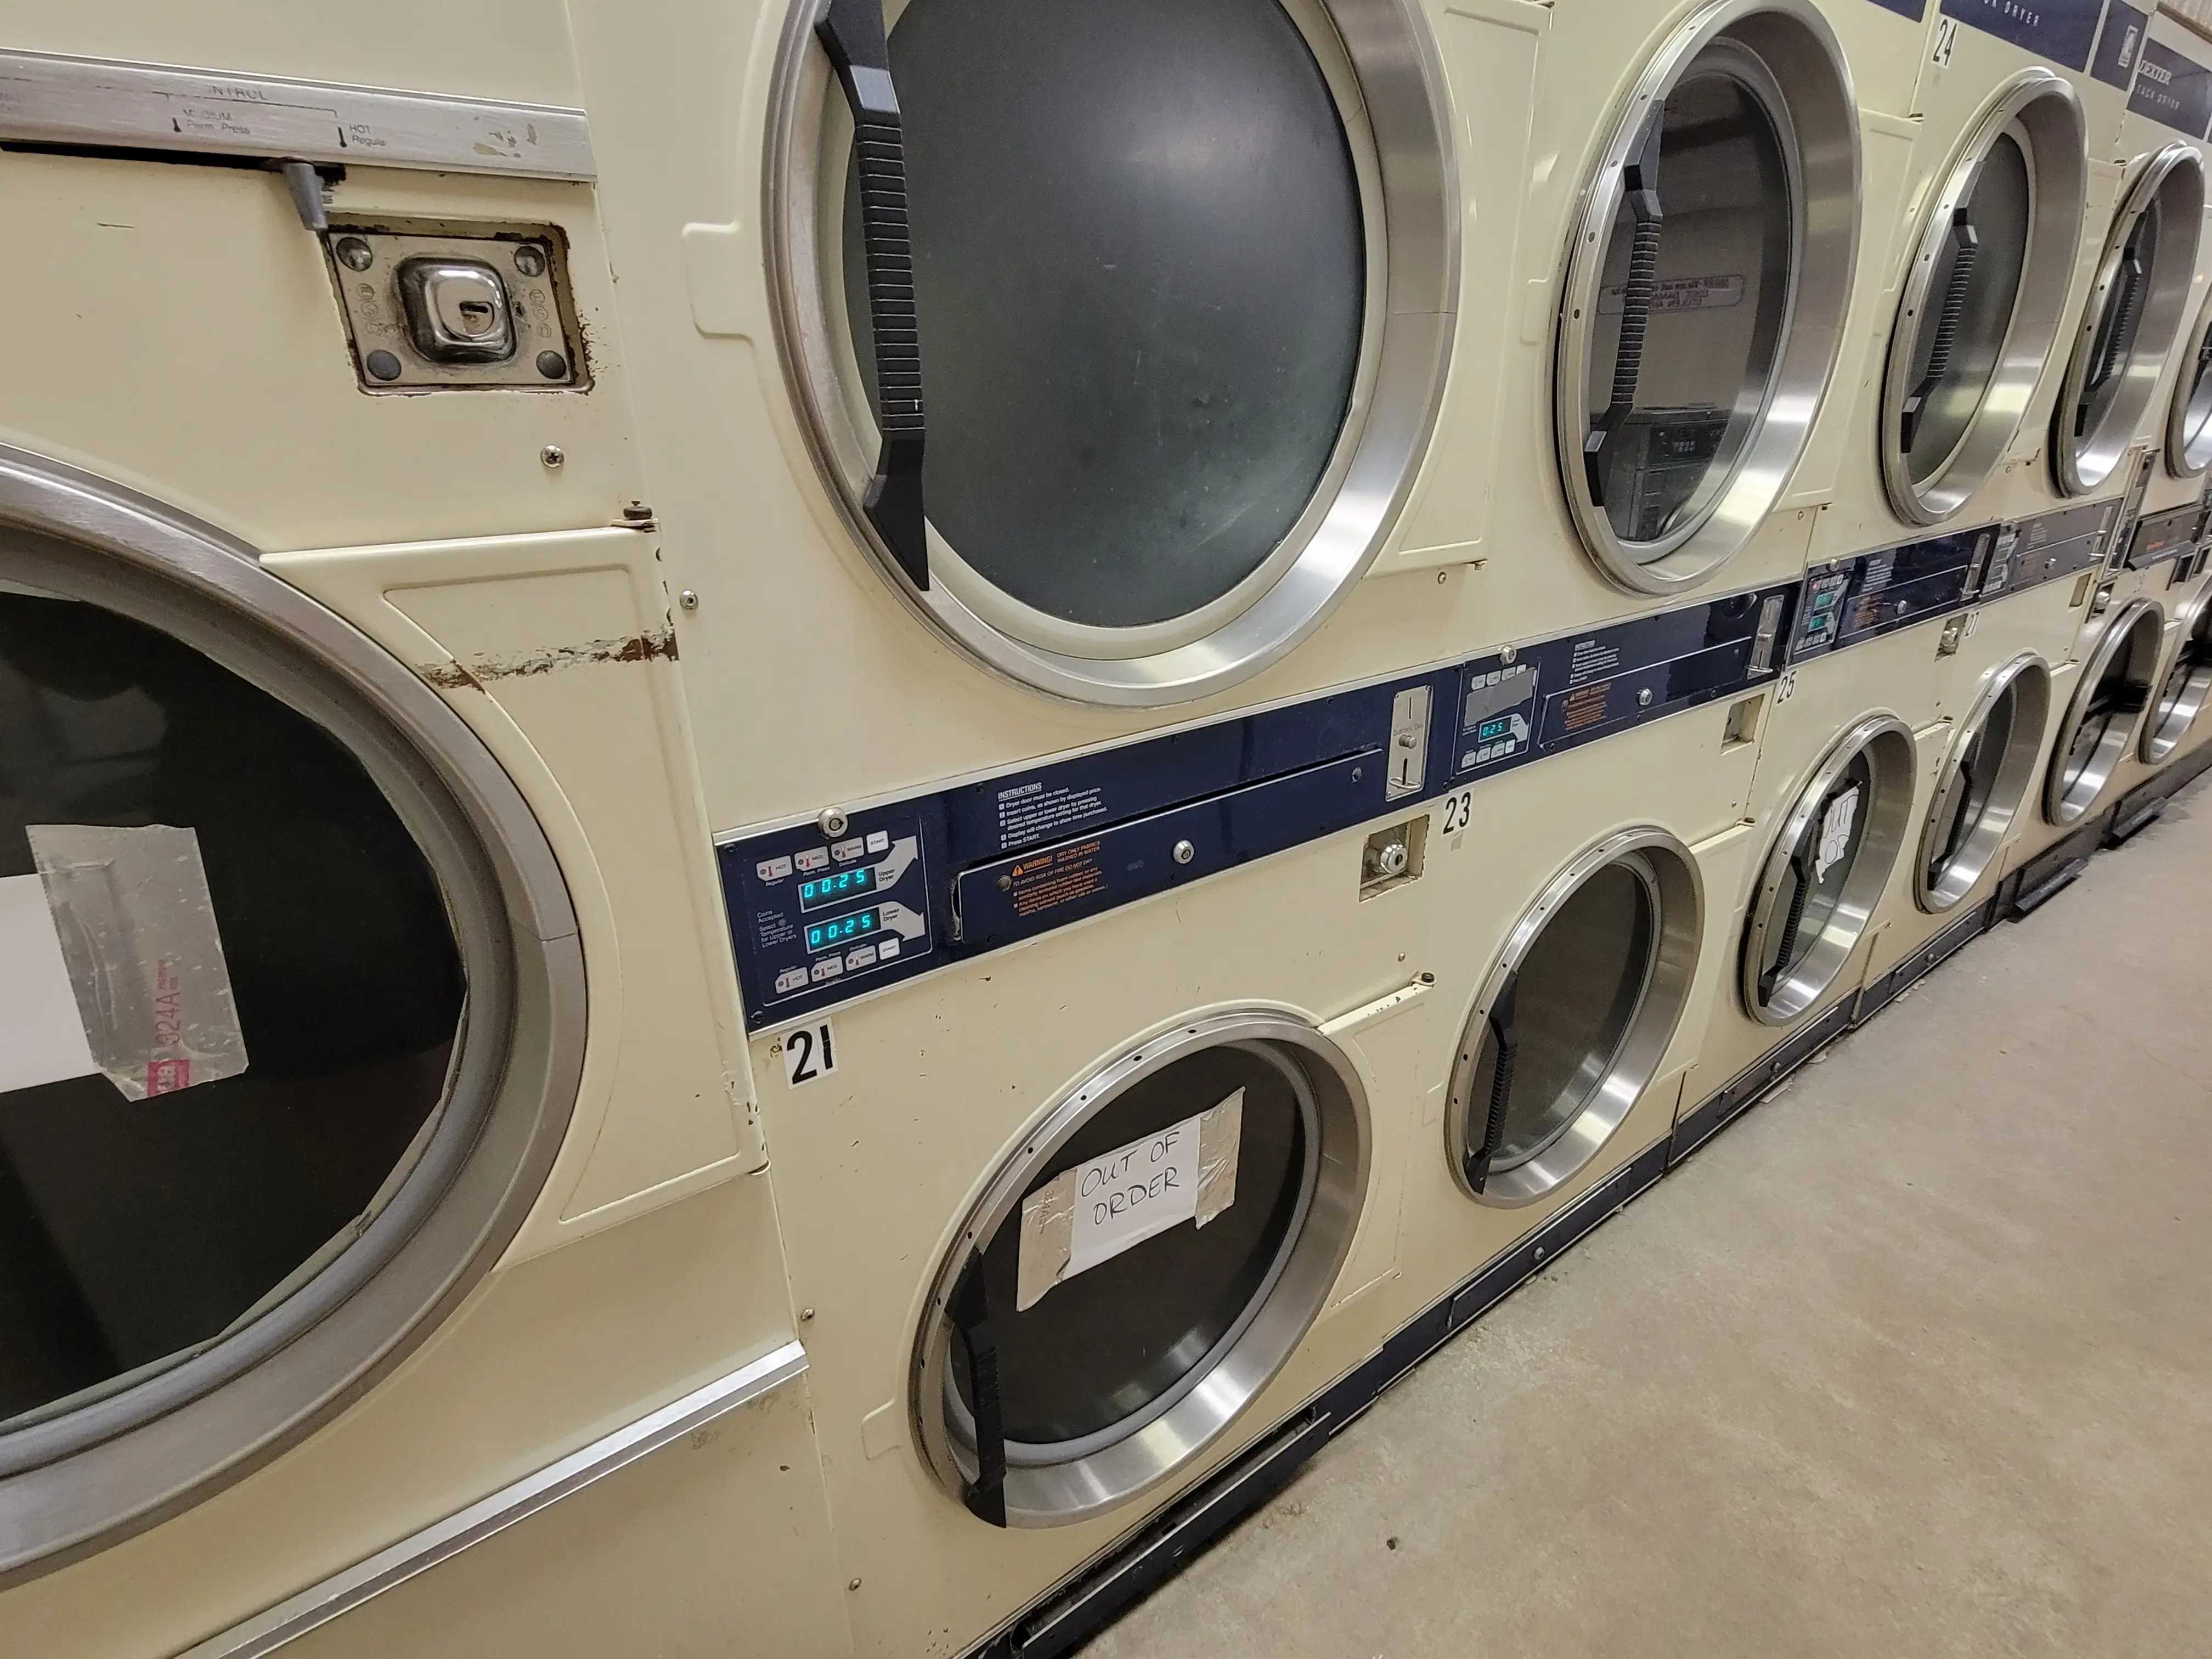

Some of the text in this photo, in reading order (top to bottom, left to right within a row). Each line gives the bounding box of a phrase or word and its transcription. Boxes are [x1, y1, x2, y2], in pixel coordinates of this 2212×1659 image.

[2005, 1, 2039, 26] DRYER
[1933, 19, 1957, 66] 24
[2139, 60, 2171, 85] DEXTER
[222, 123, 250, 134] Press
[349, 123, 371, 134] HOT
[352, 135, 387, 147] Regula
[1777, 671, 1796, 705] 25
[998, 782, 1041, 799] INSTRUCTIONS
[1066, 791, 1088, 800] displayed
[1077, 797, 1097, 805] pressing
[1026, 814, 1054, 825] temperature
[1443, 792, 1471, 835] 23
[1008, 830, 1025, 839] Display
[1035, 822, 1052, 831] change
[1023, 856, 1052, 870] WARNING!
[878, 869, 895, 877] Upper
[804, 869, 865, 898] 00.25
[758, 912, 783, 923] Accepted
[883, 908, 900, 916] Lower
[883, 913, 899, 922] Dryer
[759, 923, 776, 932] Select
[760, 925, 793, 936] Temperature
[811, 915, 871, 944] 00.25
[769, 932, 786, 940] Upper
[779, 934, 796, 943] Dryers
[155, 992, 180, 1045] 324A
[786, 1024, 833, 1086] 21
[1081, 1131, 1181, 1198] OUT OF
[1093, 1166, 1180, 1225] ORDER
